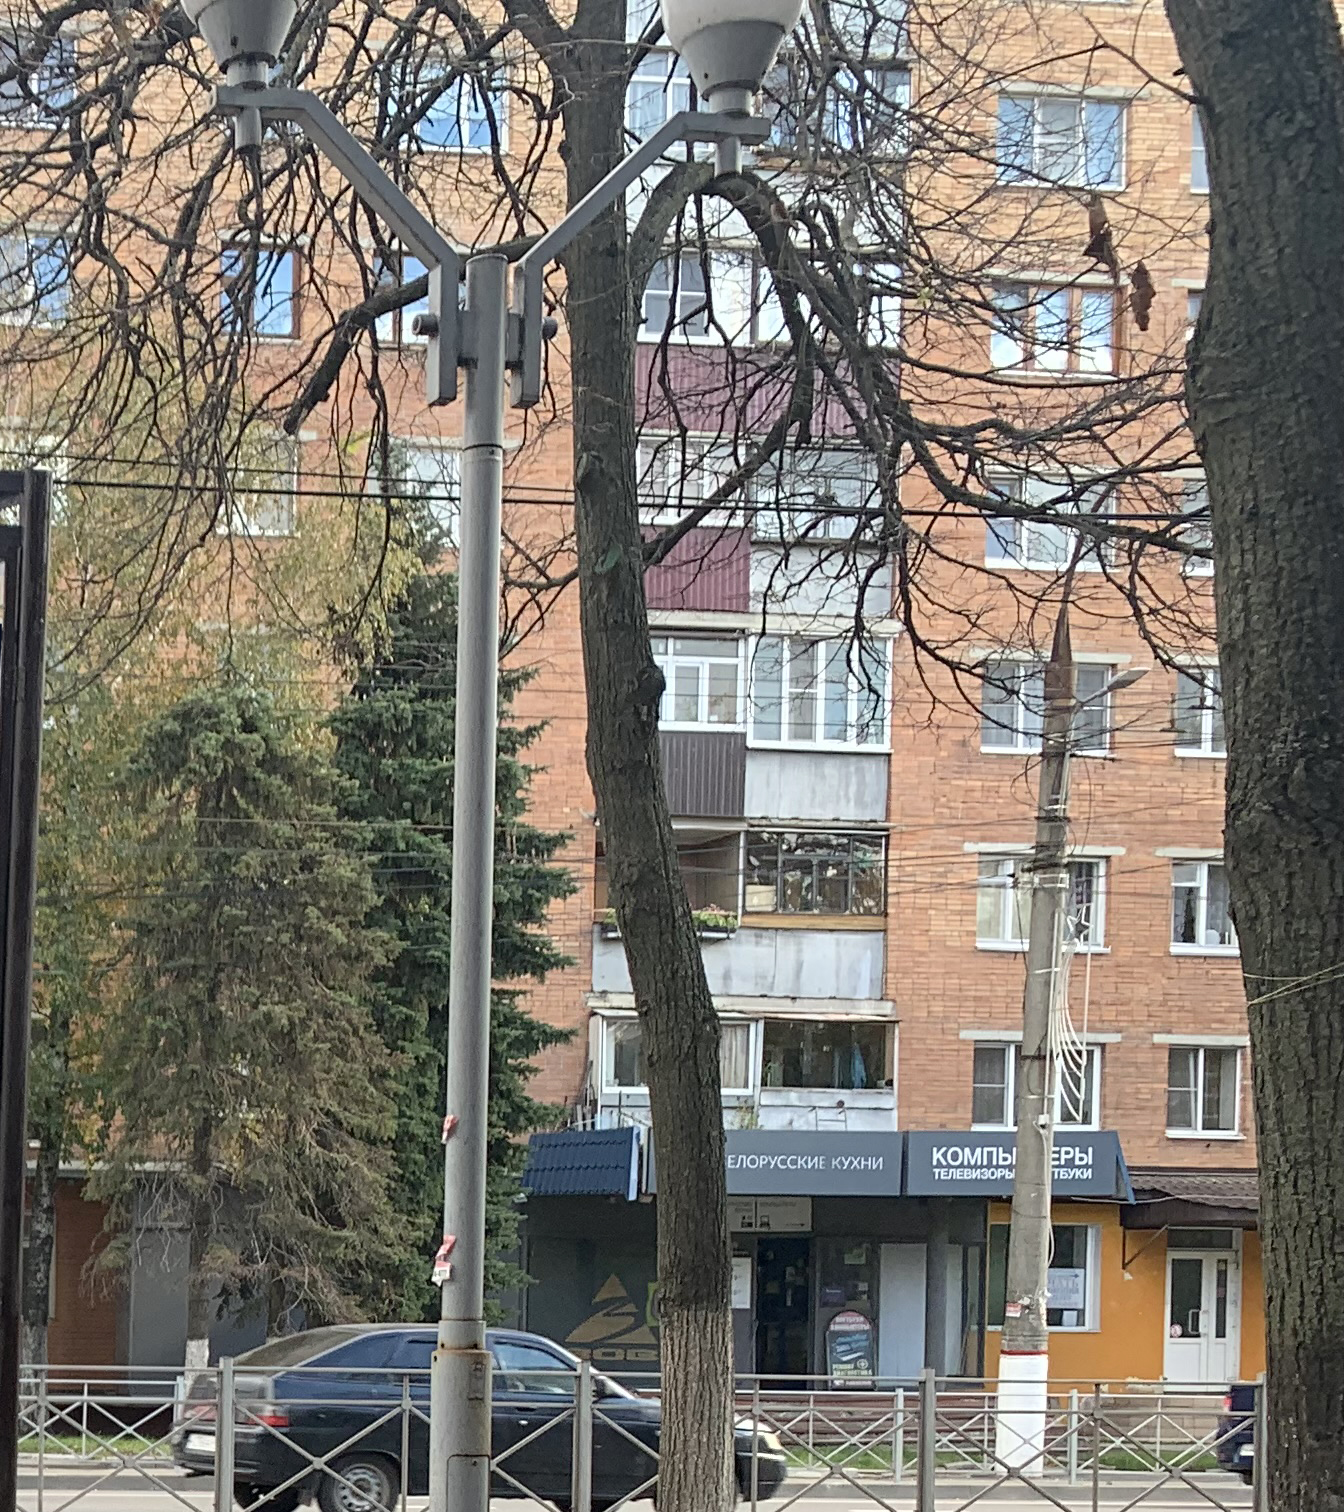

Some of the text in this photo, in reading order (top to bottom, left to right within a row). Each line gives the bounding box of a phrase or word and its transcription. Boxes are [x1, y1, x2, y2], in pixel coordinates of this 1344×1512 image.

[726, 1155, 883, 1170] ЕЛОРУССКИЕ КУХНИ
[932, 1147, 1093, 1165] КОМПЬЕРЫ
[933, 1168, 1093, 1180] ТЕЛЕВИЗОРЫ ТБУКИ
